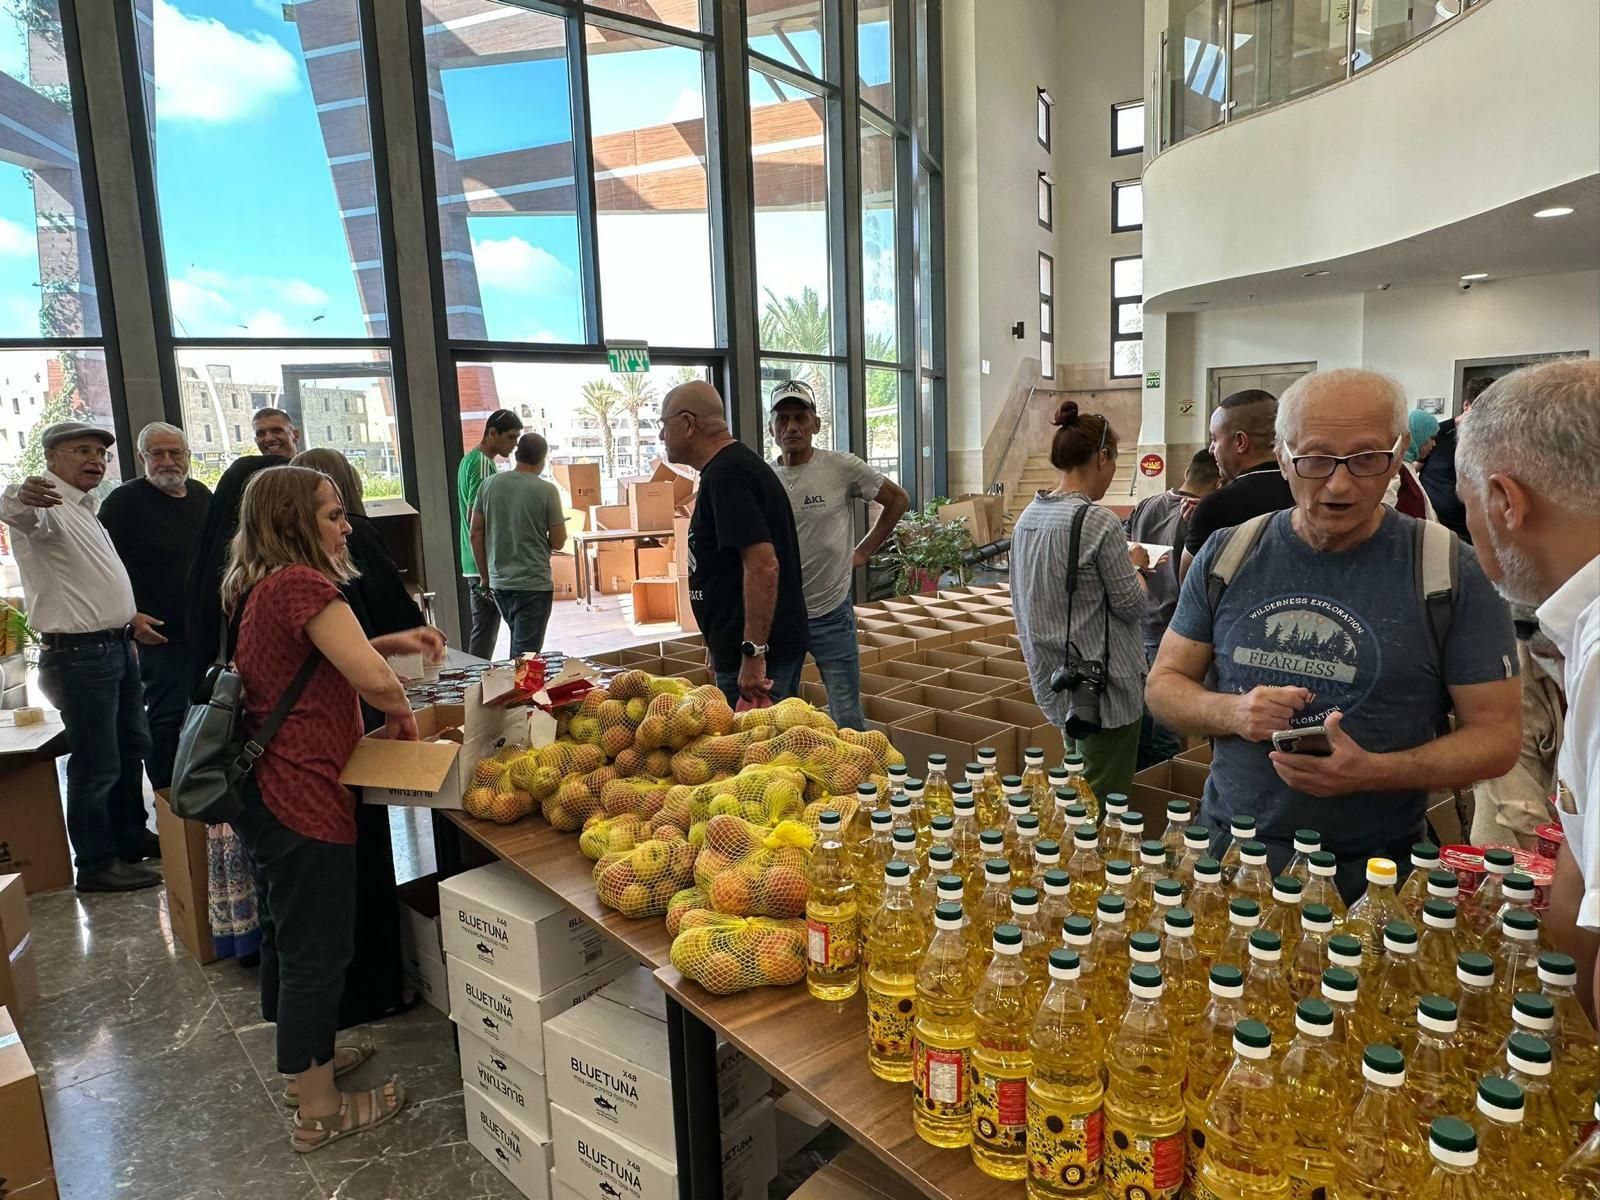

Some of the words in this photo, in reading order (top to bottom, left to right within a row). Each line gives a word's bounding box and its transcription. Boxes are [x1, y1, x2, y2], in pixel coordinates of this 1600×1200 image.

[609, 349, 648, 371] יציאה
[1249, 597, 1308, 619] WILDERNESS
[1310, 598, 1365, 634] EXPLORATION
[1248, 652, 1336, 677] FEARLESS
[1290, 705, 1342, 725] PLORATION
[458, 910, 509, 943] BLUETUNA
[465, 983, 514, 1020] BLUETUNA
[477, 1065, 525, 1107] BLUETUNA
[571, 1056, 639, 1101] BLUETUNA
[480, 1111, 522, 1158] BLUETUNA
[577, 1140, 642, 1191] BLUETUNA
